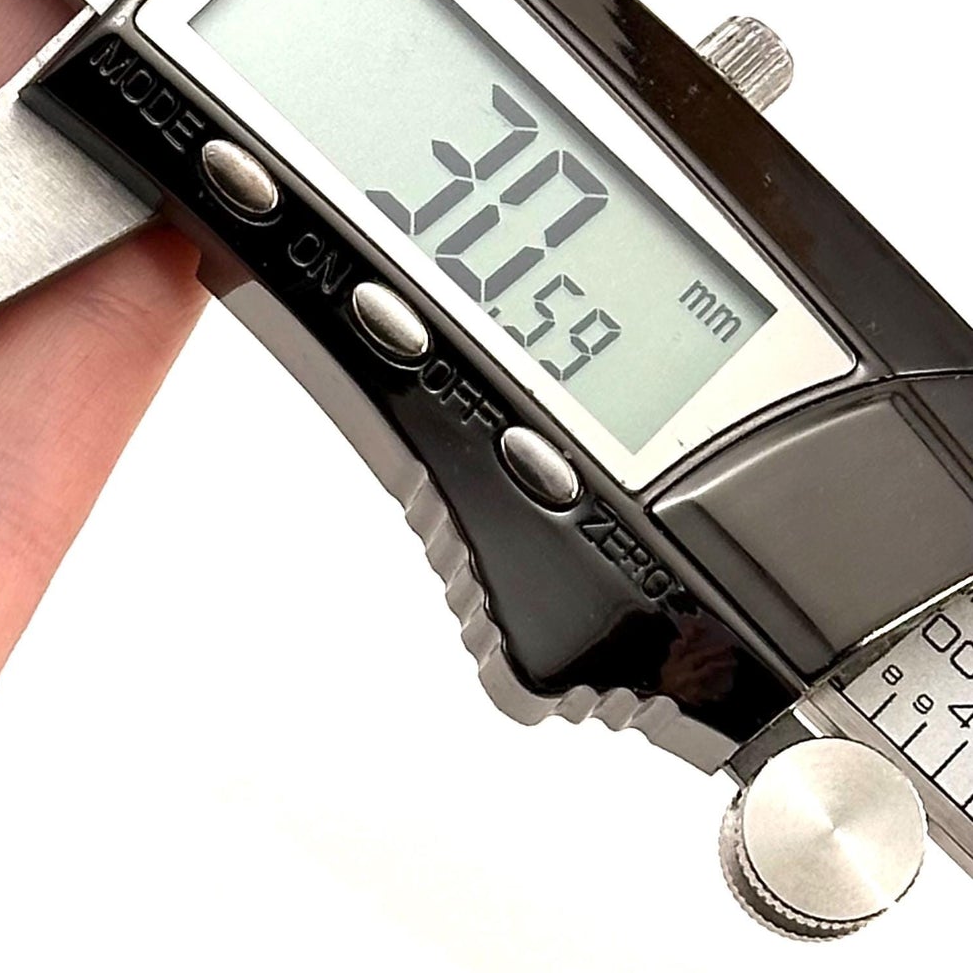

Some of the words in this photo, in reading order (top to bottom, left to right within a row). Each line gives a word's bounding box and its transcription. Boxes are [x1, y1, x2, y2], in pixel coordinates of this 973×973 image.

[89, 37, 206, 155] MODE
[287, 232, 354, 295] ON
[365, 83, 622, 382] 30.59
[678, 279, 743, 344] mm
[419, 359, 507, 428] OFF
[576, 499, 674, 601] ZERO
[881, 664, 903, 685] 8
[912, 693, 934, 714] 9
